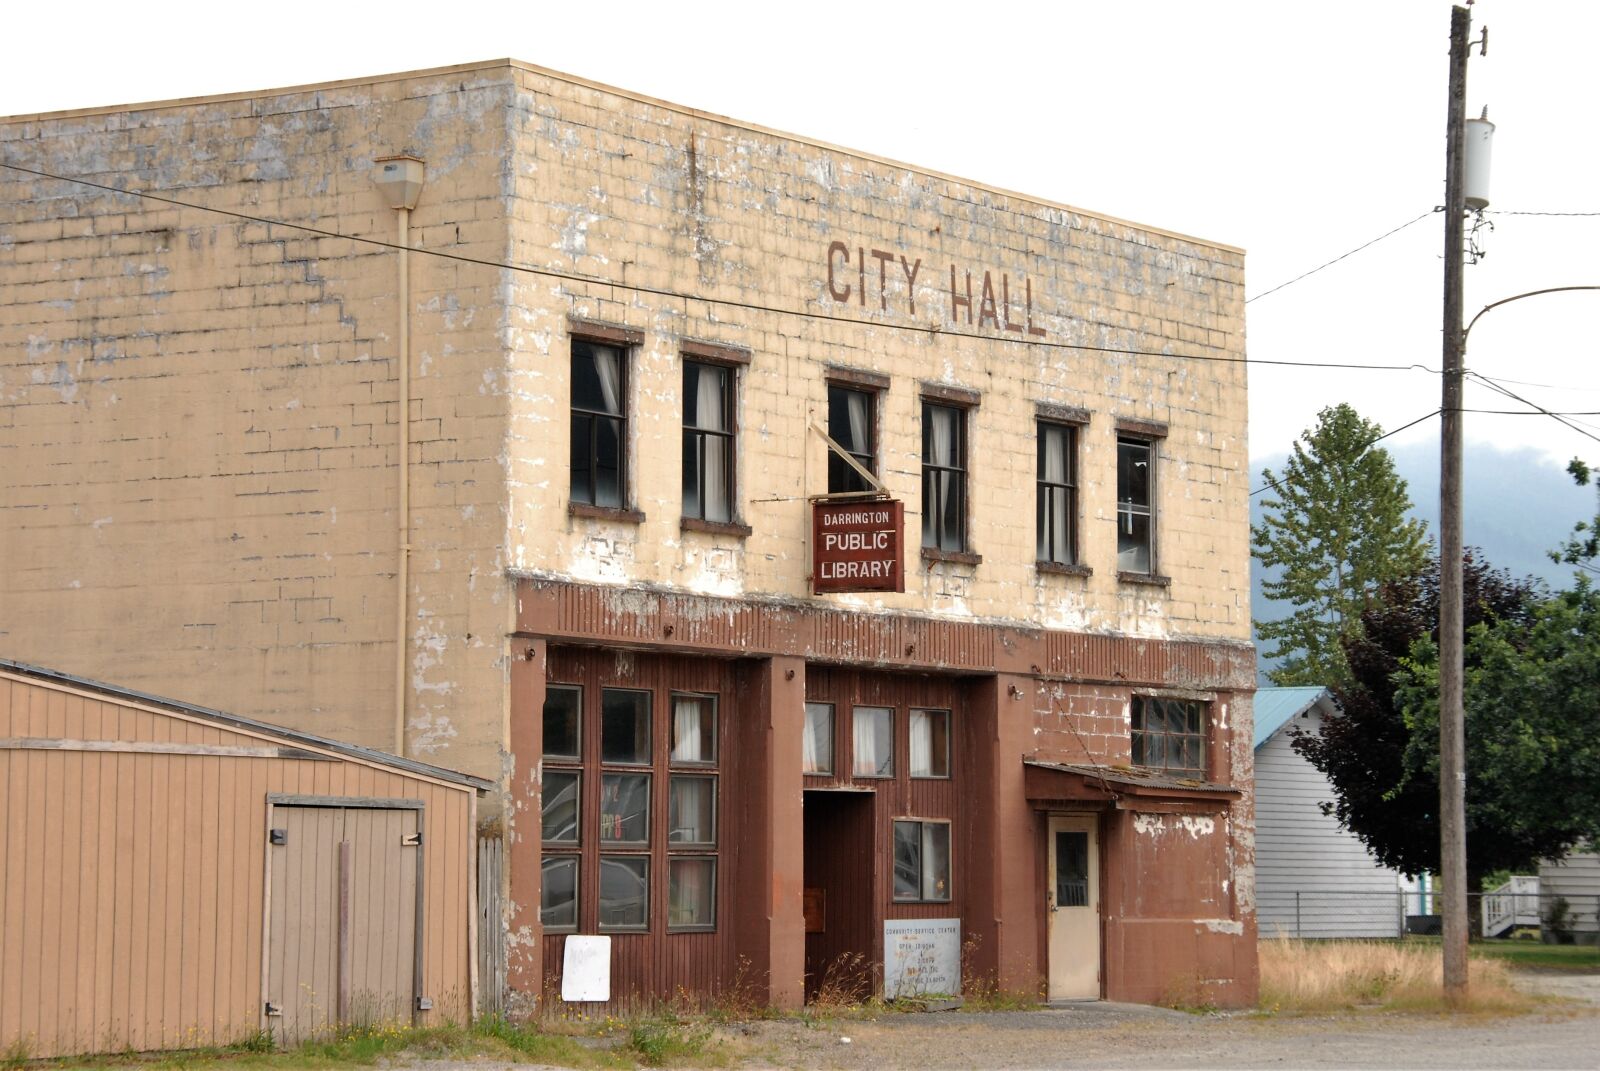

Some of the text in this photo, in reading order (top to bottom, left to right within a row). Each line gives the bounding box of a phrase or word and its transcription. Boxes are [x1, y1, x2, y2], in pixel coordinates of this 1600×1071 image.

[827, 240, 1047, 337] CITY HALL
[823, 511, 889, 526] DARRINGTON
[825, 532, 888, 551] PUBLIC
[821, 560, 892, 579] LIBRARY
